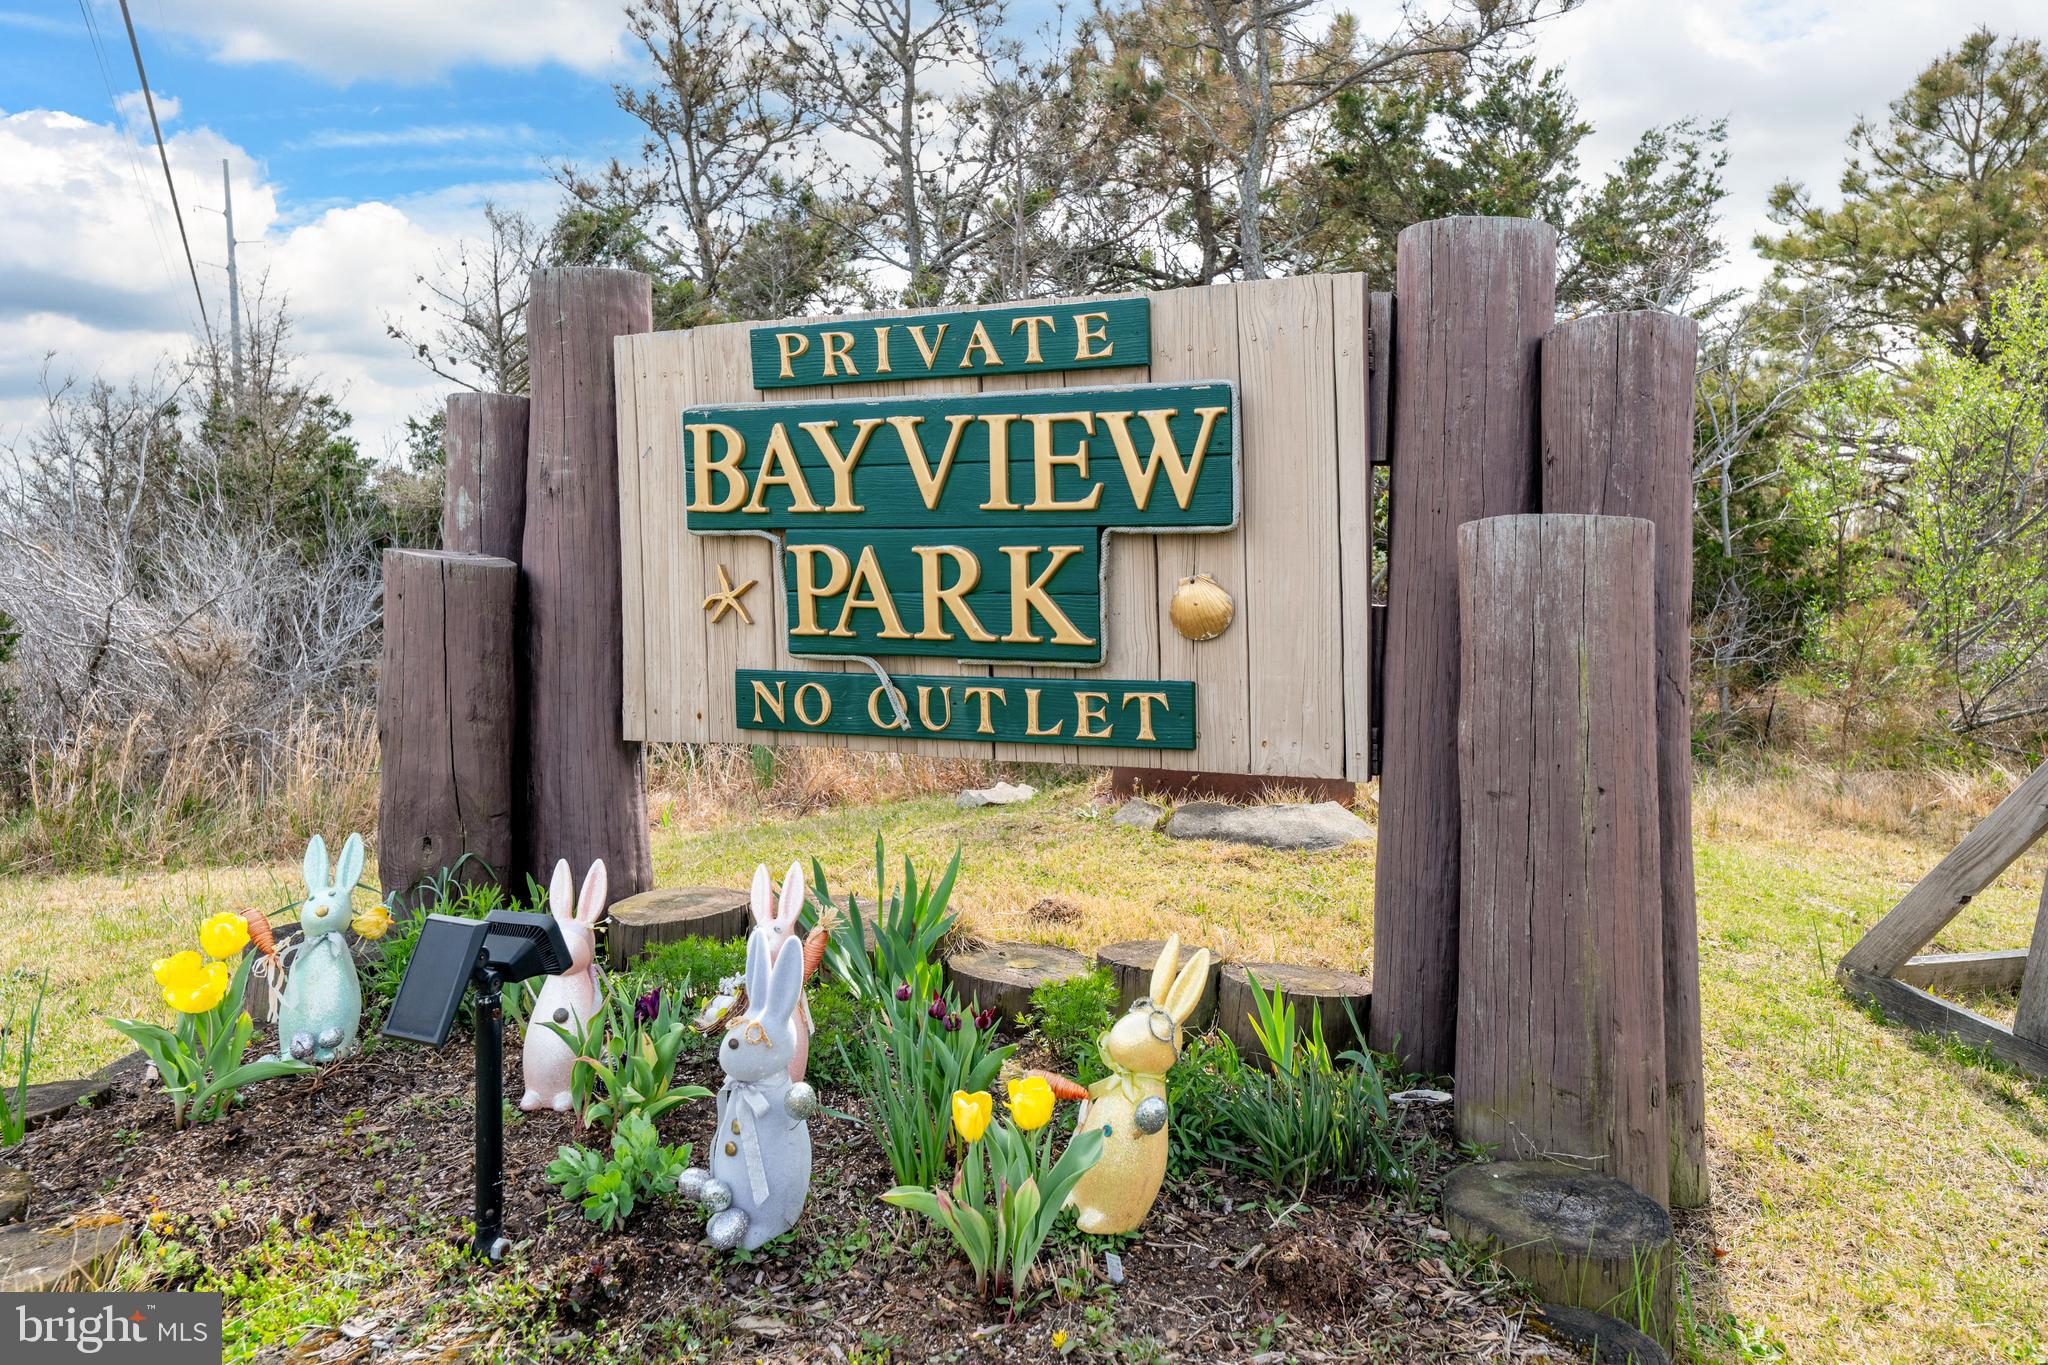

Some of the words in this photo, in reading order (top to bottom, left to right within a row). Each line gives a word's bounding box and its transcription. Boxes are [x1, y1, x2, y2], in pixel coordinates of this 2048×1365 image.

[776, 312, 1114, 379] PRIVATE
[685, 407, 1228, 513] BAYVIEW
[786, 544, 1097, 646] PARK
[750, 680, 832, 727] NO
[867, 686, 1170, 741] OUTLET
